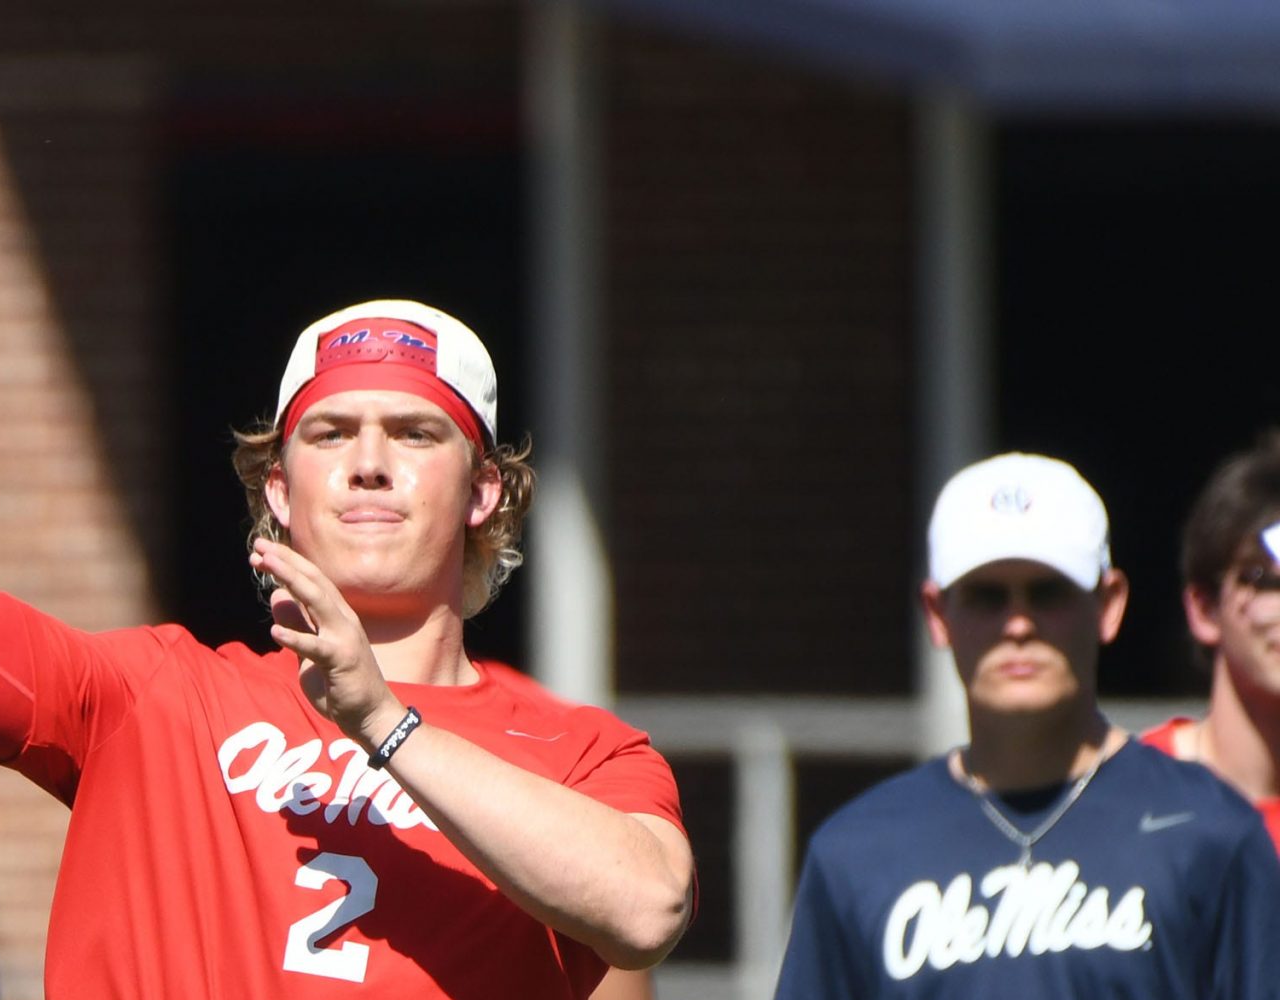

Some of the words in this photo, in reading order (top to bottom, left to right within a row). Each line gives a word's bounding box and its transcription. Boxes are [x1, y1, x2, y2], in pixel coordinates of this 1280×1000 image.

[218, 721, 333, 816] Ole
[282, 851, 379, 983] 2
[883, 872, 990, 981] Ole
[980, 859, 1153, 957] Miss
